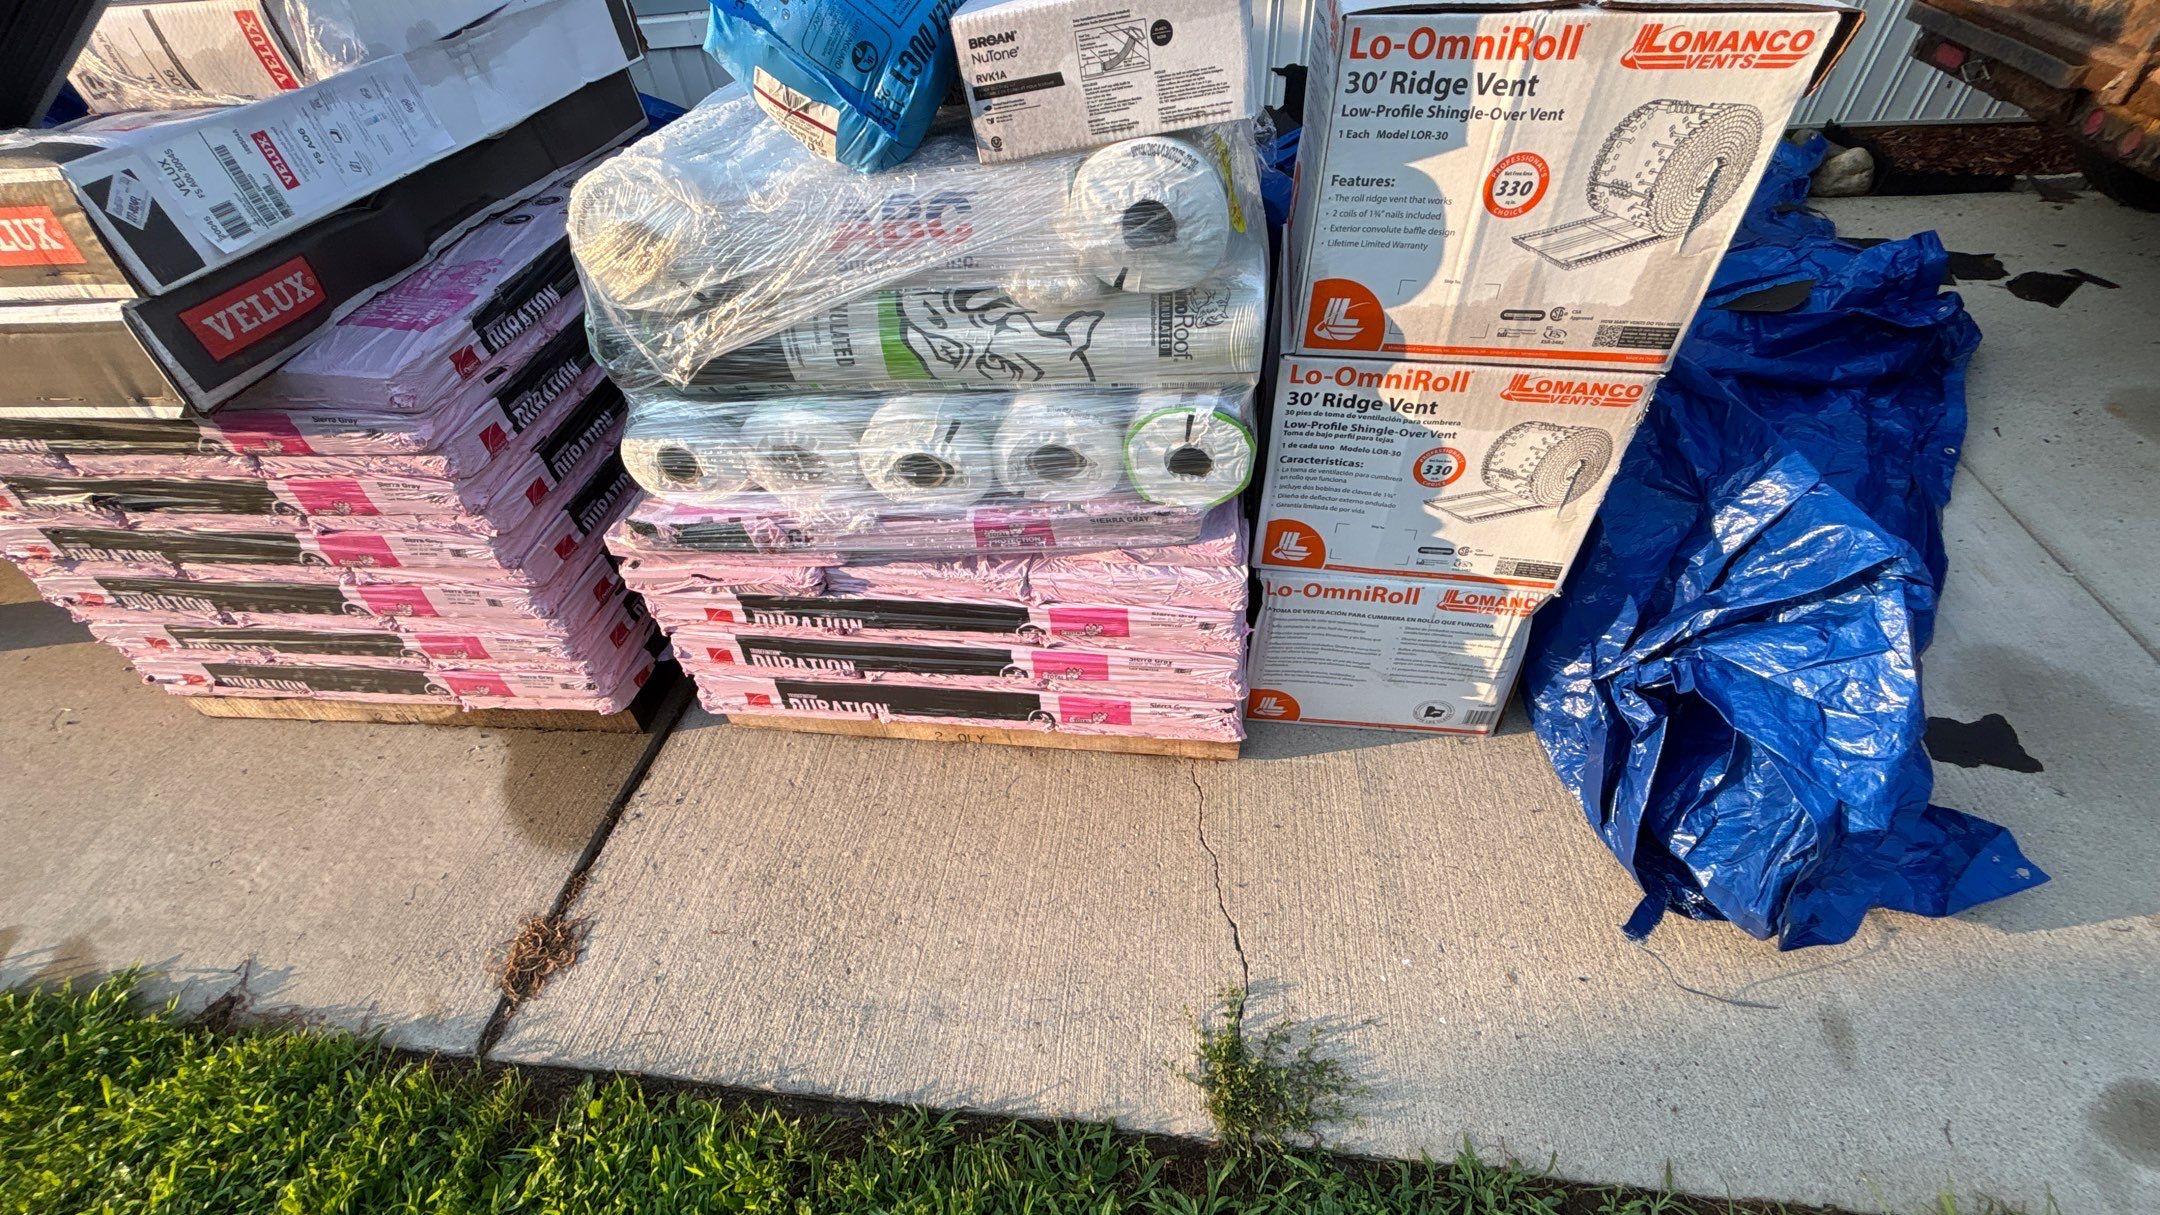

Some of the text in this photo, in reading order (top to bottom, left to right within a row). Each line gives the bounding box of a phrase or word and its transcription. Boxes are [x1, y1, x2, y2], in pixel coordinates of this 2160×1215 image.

[968, 31, 1015, 49] BROAN
[1350, 24, 1585, 61] Lo-OmniRoll
[1634, 23, 1815, 54] LOMANCO
[240, 16, 288, 84] VELUX
[889, 23, 936, 88] DUCT
[971, 49, 1018, 65] NuTone
[1685, 54, 1757, 69] VENTS
[976, 70, 1007, 83] RVK1A
[1390, 70, 1468, 100] Ridge
[1476, 71, 1540, 97] Vent
[1341, 104, 1565, 123] Low-Profile Shingle-Over Vent
[1338, 130, 1449, 141] 1 Each Model LOR-30
[257, 136, 293, 187] VELUX
[313, 152, 325, 165] FS
[158, 158, 190, 197] VELUX
[185, 171, 205, 199] FS A06
[1331, 174, 1396, 187] Features:
[1495, 181, 1533, 196] 330
[1335, 194, 1349, 203] The
[1350, 194, 1365, 203] roll
[1366, 194, 1385, 205] ridge
[1409, 196, 1427, 204] that
[1428, 197, 1453, 206] works
[1332, 209, 1441, 220] 2 coils of nails included
[0, 217, 64, 251] LUX
[1330, 225, 1456, 238] Exterior convolute baffle design
[1327, 239, 1428, 252] Lifetime Limited Warranty
[201, 271, 315, 341] VELUX
[487, 284, 561, 351] DURATION
[1160, 294, 1171, 349] RANULATED
[829, 302, 855, 367] NULATED
[1290, 364, 1471, 393] Lo-OmniRoll
[1509, 374, 1643, 398] LOMANCO
[512, 359, 582, 429] DURATION
[1550, 395, 1601, 406] VENTS
[1322, 393, 1383, 413] Ridge
[1389, 397, 1438, 415] Vent
[338, 417, 358, 425] Gray
[1358, 413, 1401, 423] ventilación
[1284, 420, 1457, 440] Low-Profile Shingle-Over Vent
[1316, 431, 1333, 439] bajo
[1334, 432, 1354, 441] perfil
[1356, 434, 1374, 442] para
[1375, 436, 1394, 444] tejas
[1339, 445, 1370, 454] Modelo
[1372, 448, 1402, 457] LOR-30
[1371, 474, 1403, 482] cumbrera
[1423, 465, 1452, 475] 330
[1318, 476, 1347, 484] funciona
[1089, 515, 1149, 525] SIERRA GRAY
[1266, 581, 1420, 606] Lo-OmniRoll
[1443, 589, 1538, 610] LOMANC
[753, 611, 863, 629] DURATION
[1477, 606, 1518, 616] VENTS
[1367, 614, 1405, 622] CUMBRERA
[1457, 621, 1494, 629] FUNCIONA
[751, 654, 856, 671] DURATION
[788, 697, 890, 715] DURATION
